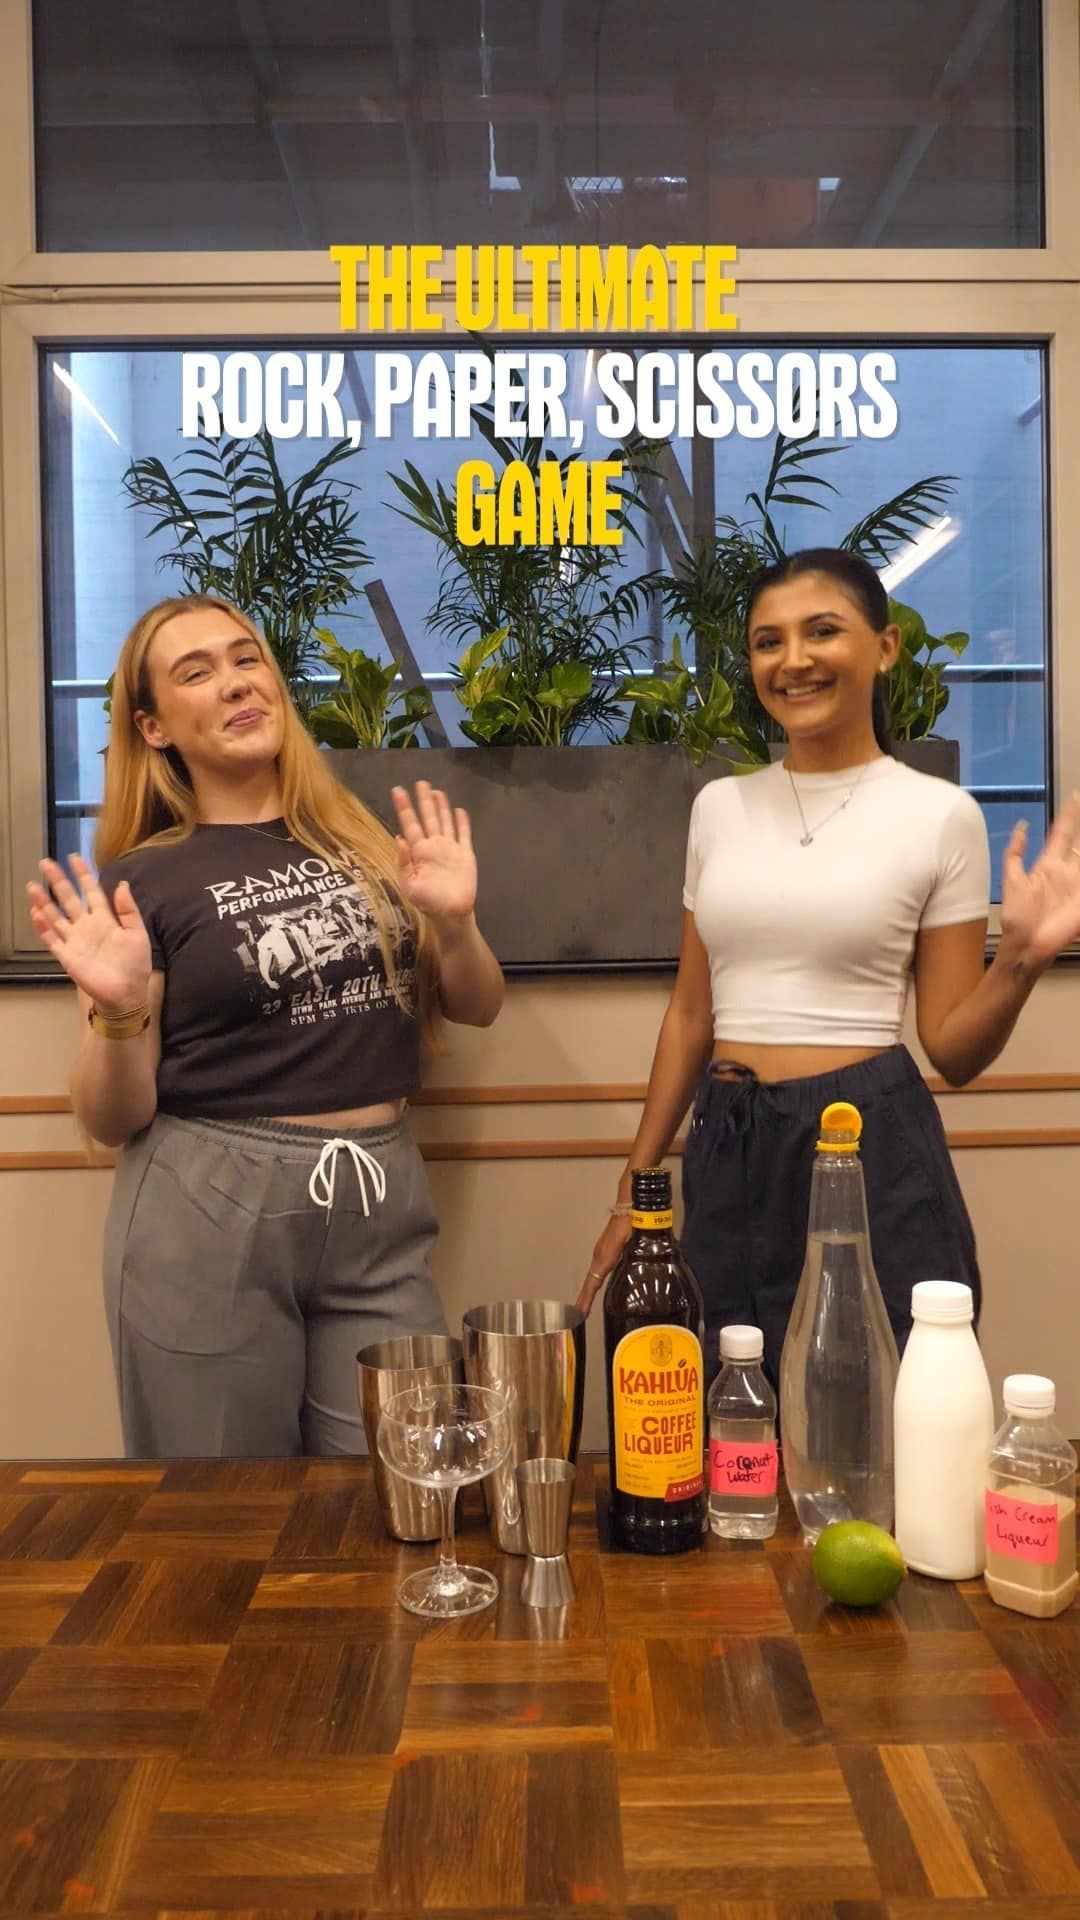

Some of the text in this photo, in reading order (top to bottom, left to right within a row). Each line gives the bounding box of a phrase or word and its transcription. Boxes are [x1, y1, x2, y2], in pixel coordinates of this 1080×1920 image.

[217, 873, 347, 920] PERFORMANCE
[290, 984, 333, 1007] EAST
[341, 973, 380, 997] 20TH
[625, 1395, 696, 1407] THE ORIGINAL
[641, 1411, 697, 1436] COFFEE
[624, 1432, 693, 1455] LIQUEUR
